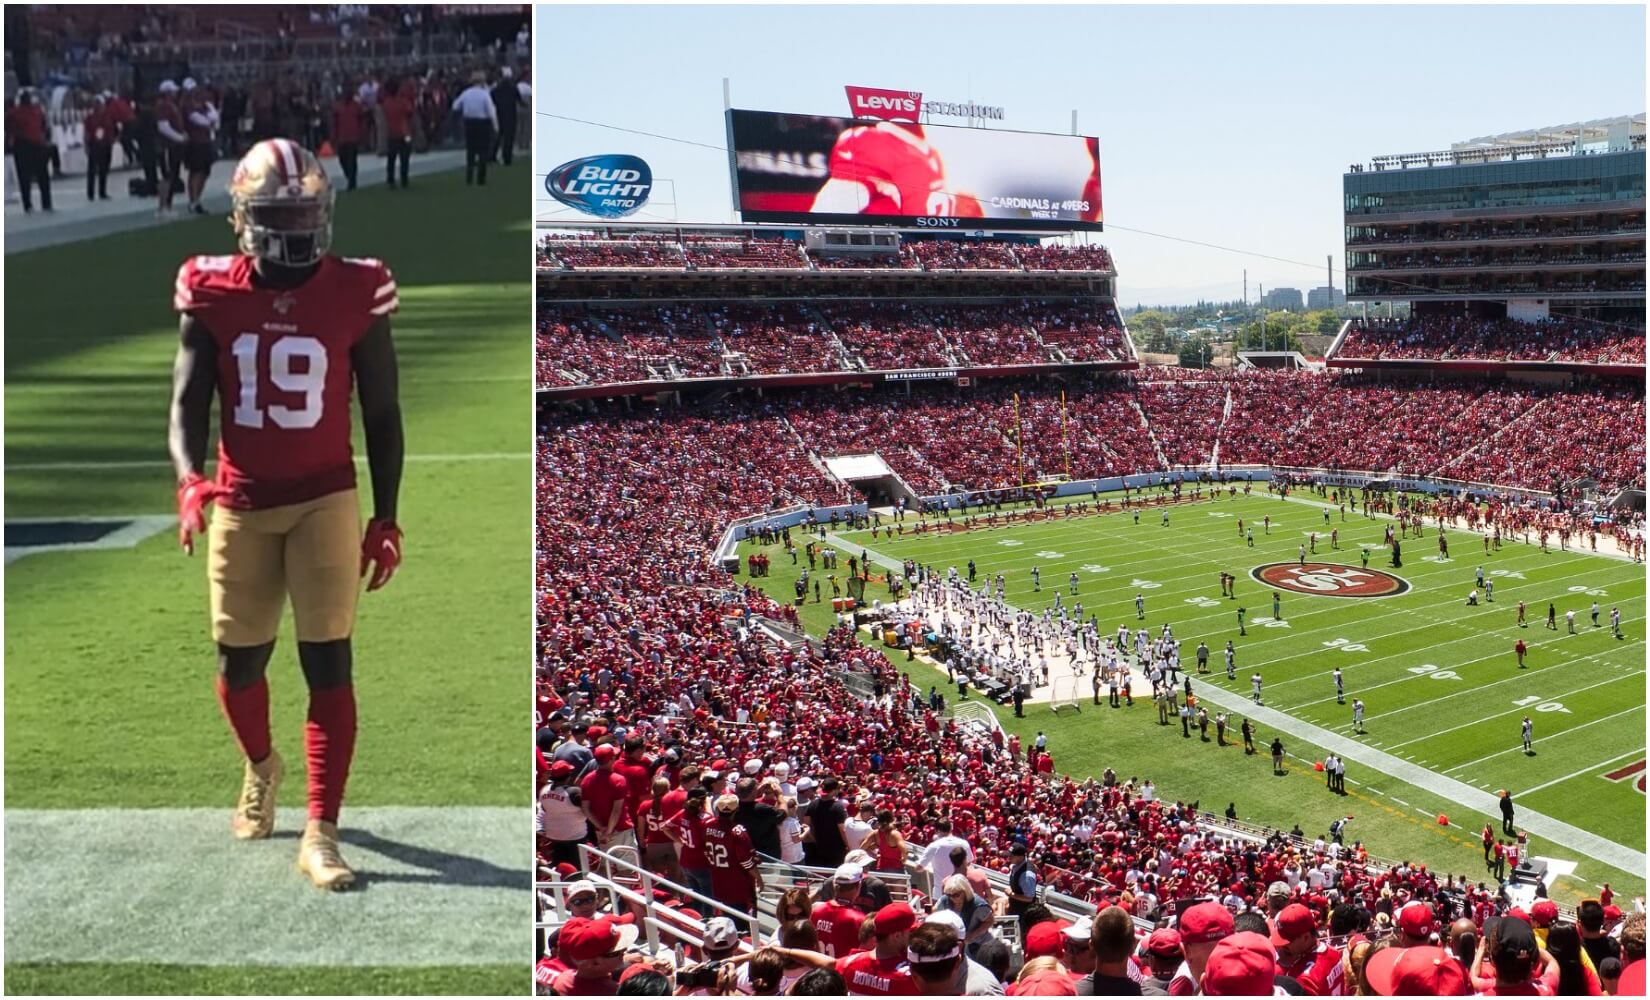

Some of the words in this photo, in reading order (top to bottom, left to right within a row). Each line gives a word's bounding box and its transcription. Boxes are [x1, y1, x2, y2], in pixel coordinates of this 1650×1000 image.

[926, 101, 1005, 120] STADIUM
[563, 180, 650, 197] LIGHT
[600, 199, 635, 208] PATIO
[991, 196, 1050, 210] CARDINALS
[1051, 202, 1059, 210] AT
[1061, 200, 1090, 212] 49ERS
[916, 216, 961, 228] SONY
[1031, 210, 1050, 219] WEEK
[232, 332, 328, 429] 19
[1321, 637, 1367, 653] 30
[1406, 664, 1456, 680] 20
[1511, 695, 1564, 713] 10
[679, 825, 696, 849] 21
[704, 841, 730, 868] 32
[1324, 871, 1330, 881] 5
[816, 919, 834, 933] GORE
[852, 970, 891, 992] BOWMAN
